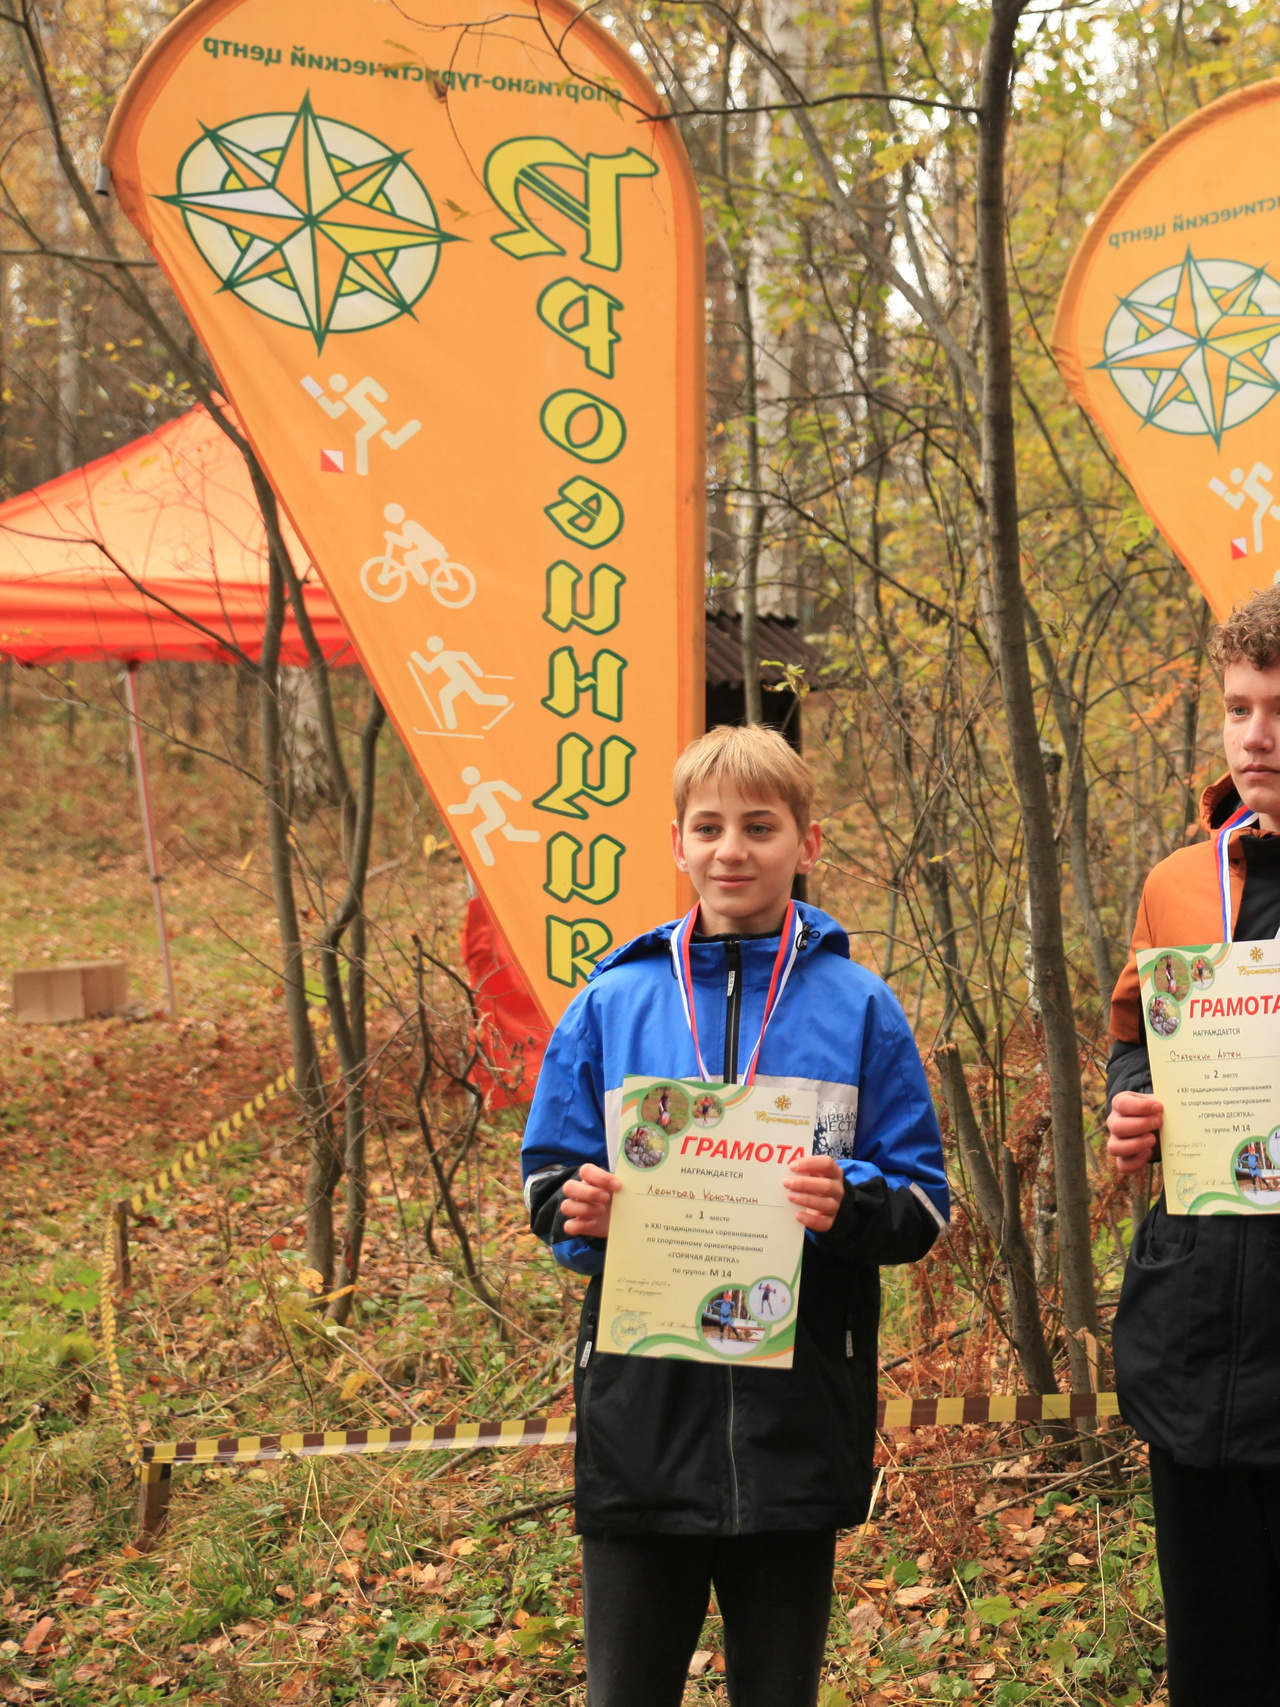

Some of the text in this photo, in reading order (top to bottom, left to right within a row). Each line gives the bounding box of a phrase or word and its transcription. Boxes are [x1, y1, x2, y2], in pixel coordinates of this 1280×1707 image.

[1192, 1028, 1241, 1037] НАГРАЖДАЕТСЯ
[1213, 1069, 1219, 1079] 2
[1242, 1124, 1251, 1132] 14
[680, 1135, 805, 1165] ГРАМОТА
[680, 1167, 744, 1179] НАГРАЖДАЕТСЯ
[647, 1184, 759, 1204] Леонтьев Константин
[699, 1210, 704, 1220] 1
[663, 1224, 714, 1235] традиционных
[715, 1229, 768, 1240] соревнованиях
[657, 1237, 702, 1248] спортивному
[703, 1242, 764, 1253] ориентированию
[722, 1269, 732, 1278] 14
